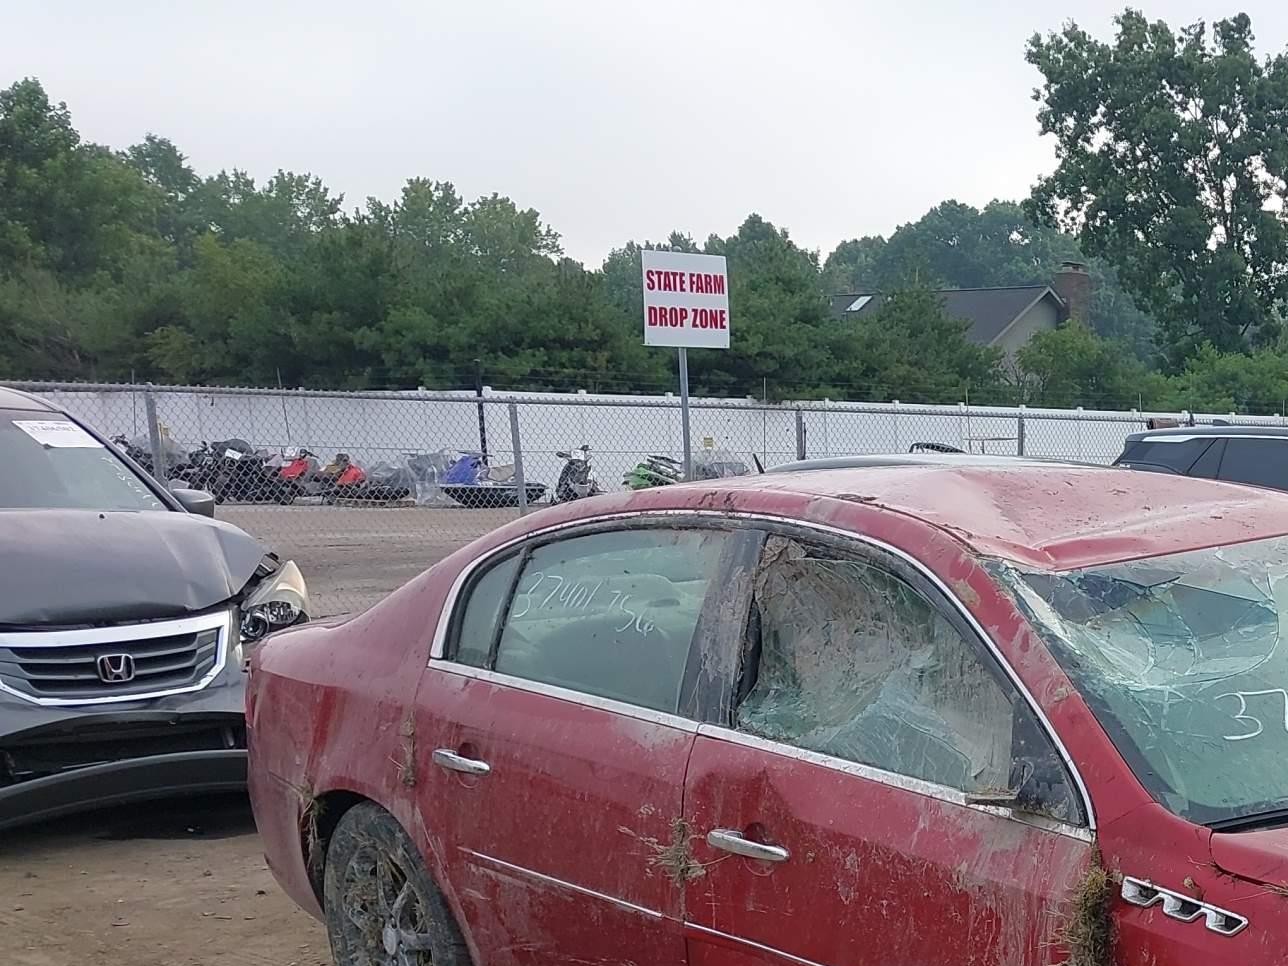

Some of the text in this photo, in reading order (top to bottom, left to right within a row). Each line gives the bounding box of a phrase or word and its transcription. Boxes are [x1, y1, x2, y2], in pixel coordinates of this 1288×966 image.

[646, 269, 725, 295] STATE FARM
[647, 305, 727, 330] DROP ZONE
